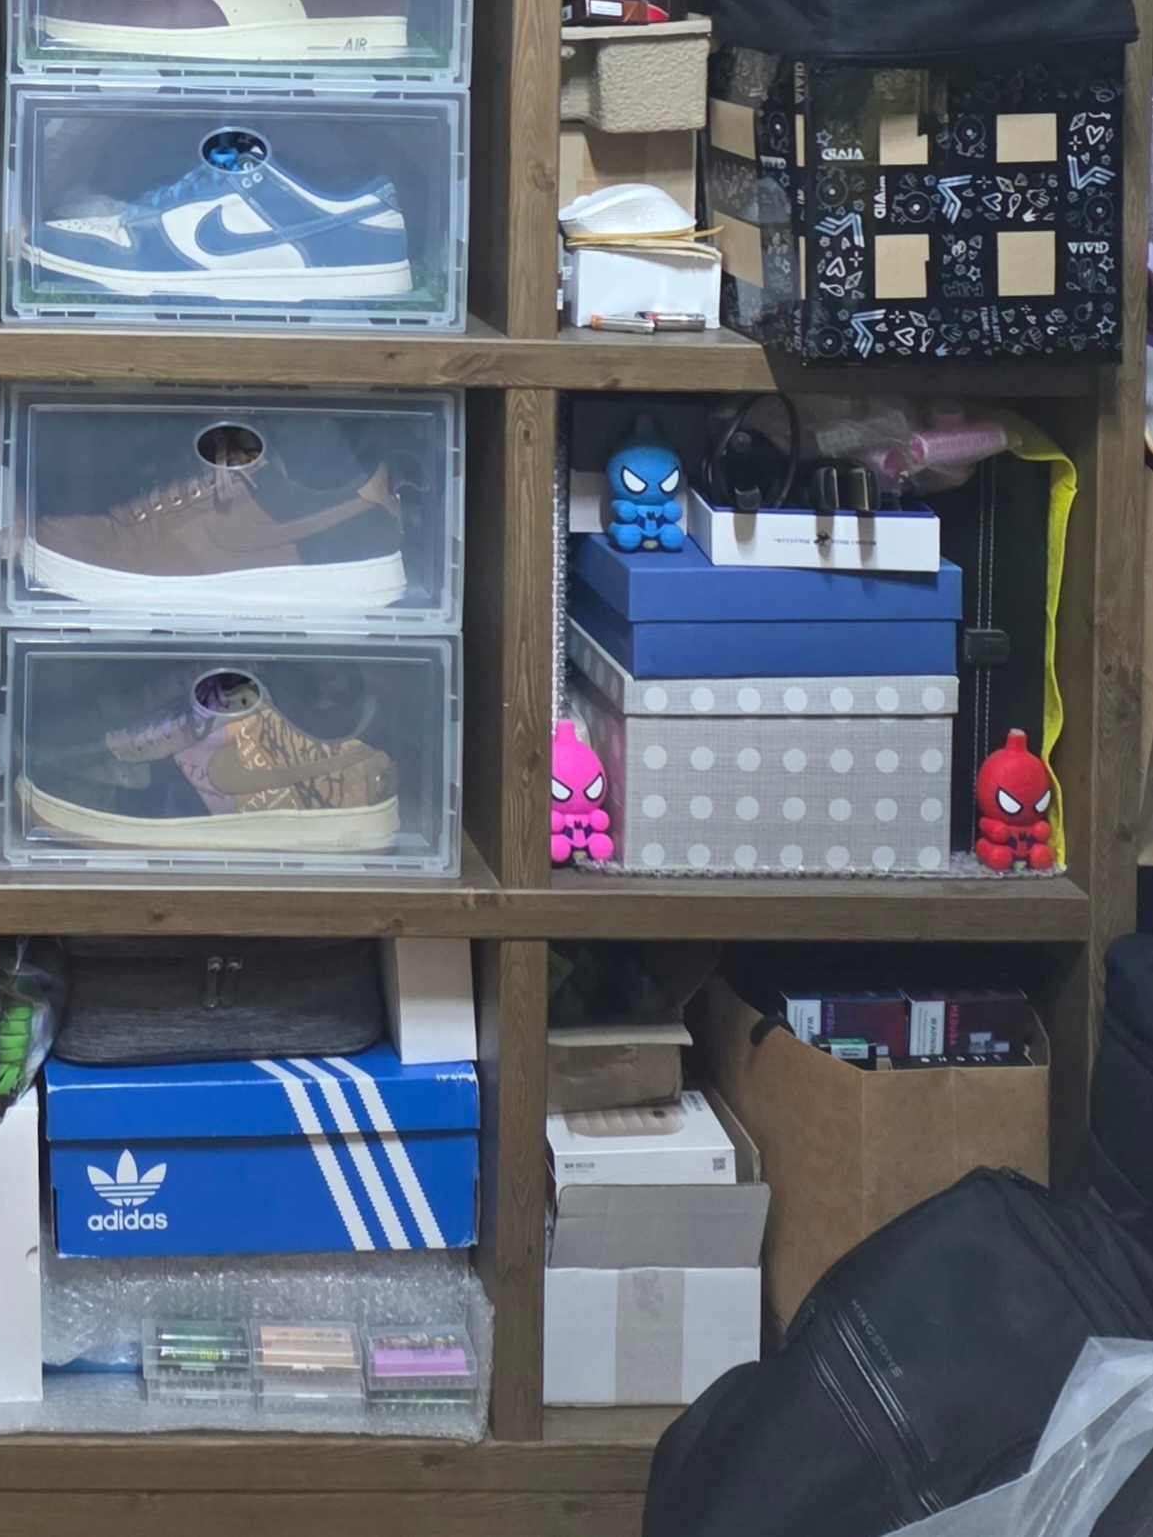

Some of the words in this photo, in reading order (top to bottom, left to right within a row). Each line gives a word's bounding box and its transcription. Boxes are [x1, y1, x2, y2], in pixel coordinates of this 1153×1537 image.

[343, 37, 368, 51] AIR
[949, 1004, 960, 1046] MEDUSA
[87, 1209, 168, 1231] adidas
[851, 1299, 904, 1378] KINGSONS
